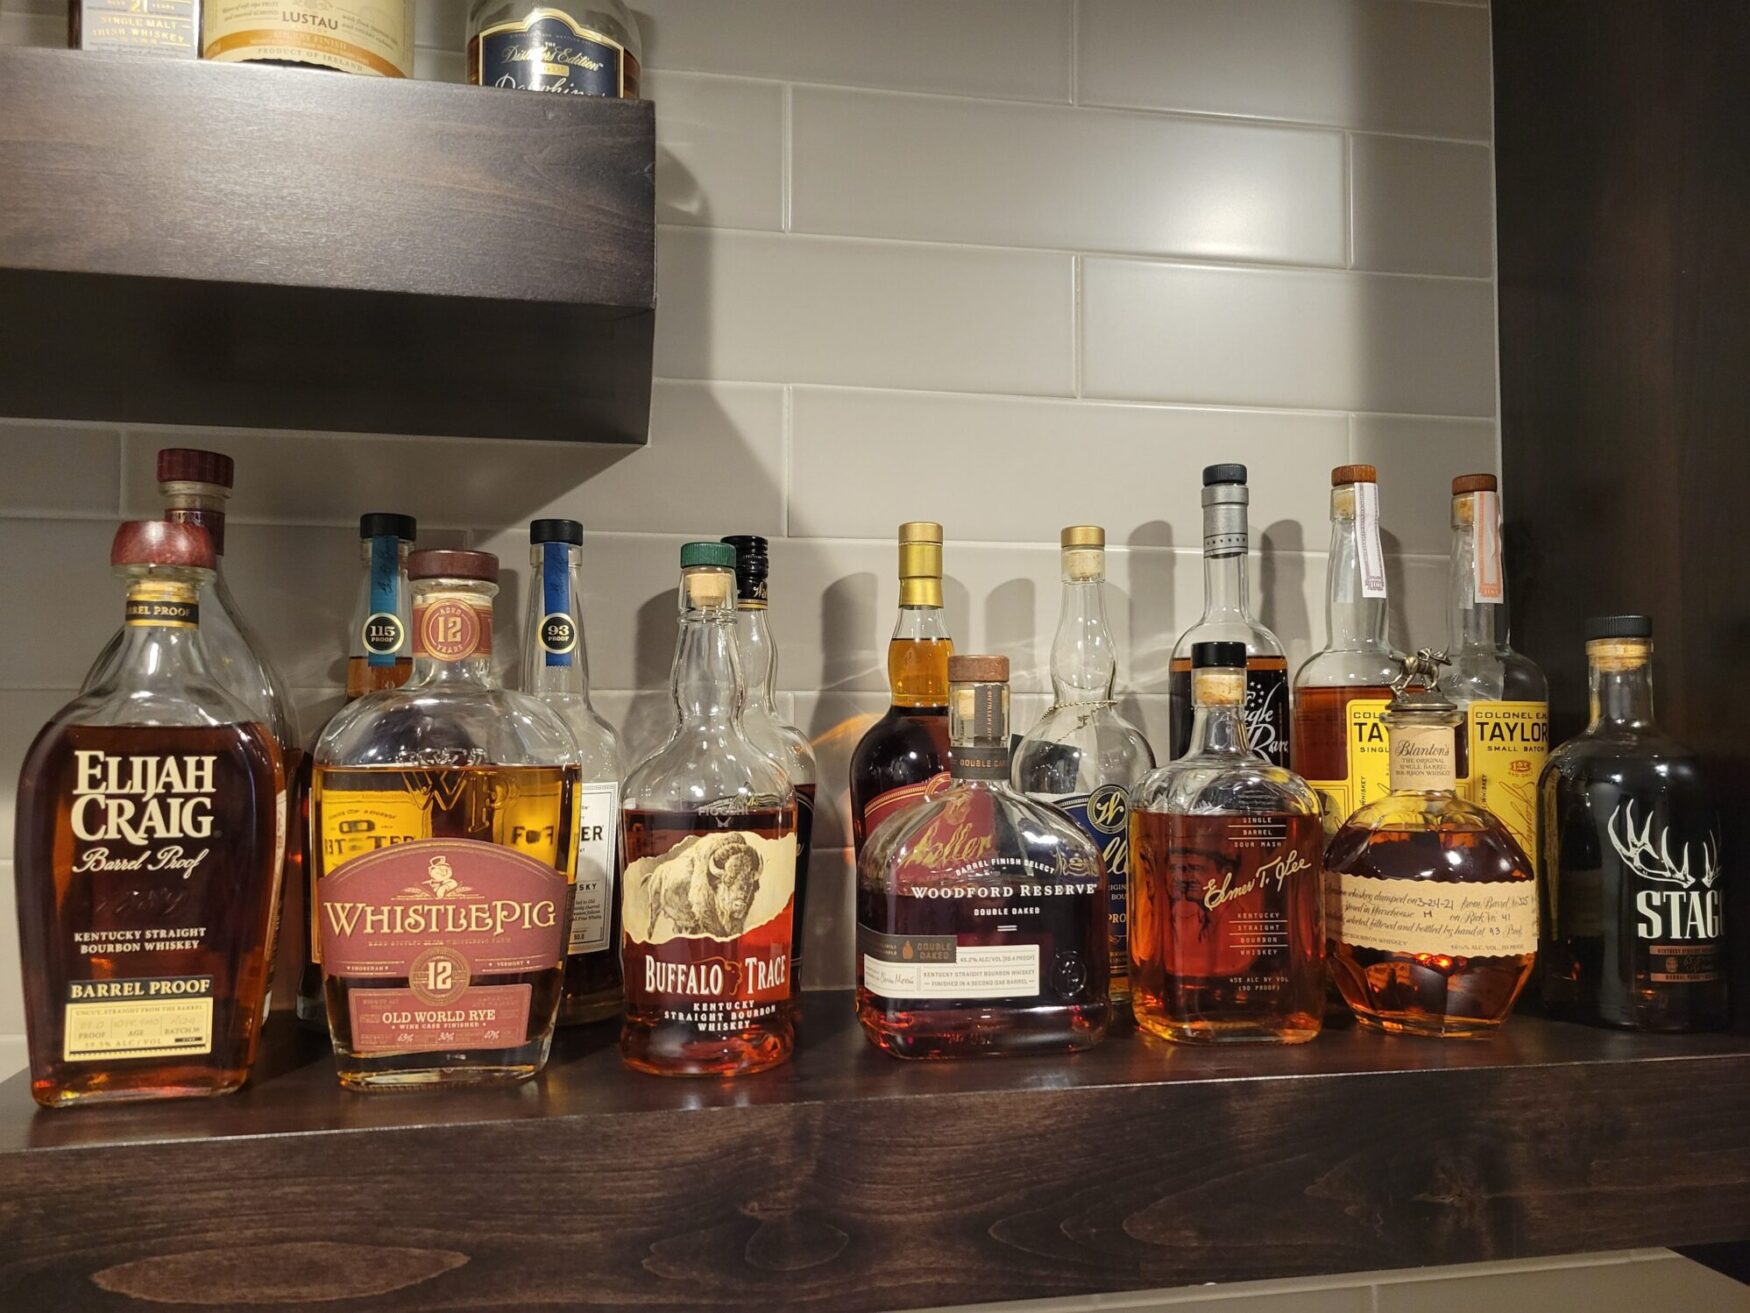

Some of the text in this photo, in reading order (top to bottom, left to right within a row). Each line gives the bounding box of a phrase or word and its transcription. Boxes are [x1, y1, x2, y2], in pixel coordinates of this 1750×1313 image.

[146, 20, 178, 30] MALT
[282, 11, 339, 30] LUSTAU
[130, 28, 185, 43] WHISKEY
[258, 48, 302, 56] PRODUCT
[322, 54, 364, 72] IRELAND
[440, 607, 462, 616] AGED
[370, 626, 395, 637] 115
[438, 616, 462, 643] 12
[548, 625, 569, 636] 93
[1475, 711, 1534, 720] COLONEL
[1475, 722, 1548, 742] TAYLOR
[1395, 740, 1450, 757] Blanton's
[960, 758, 992, 768] DOUBLE
[72, 750, 218, 802] ELIJAH
[70, 794, 215, 846] CRAIG
[72, 845, 210, 879] Barrel Proof
[956, 858, 1055, 876] BARREL FINISH SELECT
[911, 885, 1014, 899] WOODFORD
[1374, 891, 1407, 905] dumped
[974, 907, 1041, 916] DOUBLE OAKED
[1424, 910, 1433, 918] H
[1636, 890, 1724, 939] STAG
[1397, 922, 1415, 932] and
[74, 927, 207, 943] KENTUCKY STRAIGHT
[80, 940, 200, 954] BOURBON WHISKEY
[917, 943, 952, 951] DOUBLE
[920, 951, 950, 960] OAKED
[427, 961, 452, 990] 12
[645, 955, 786, 996] BUFFALO TRACE
[71, 979, 211, 998] BARREL PROOF
[664, 1004, 776, 1022] STRAIGHT BOURBON
[693, 1000, 755, 1012] KENTUCKY
[382, 1009, 496, 1024] OLD WORLD RYE
[697, 1021, 751, 1032] WHISKEY
